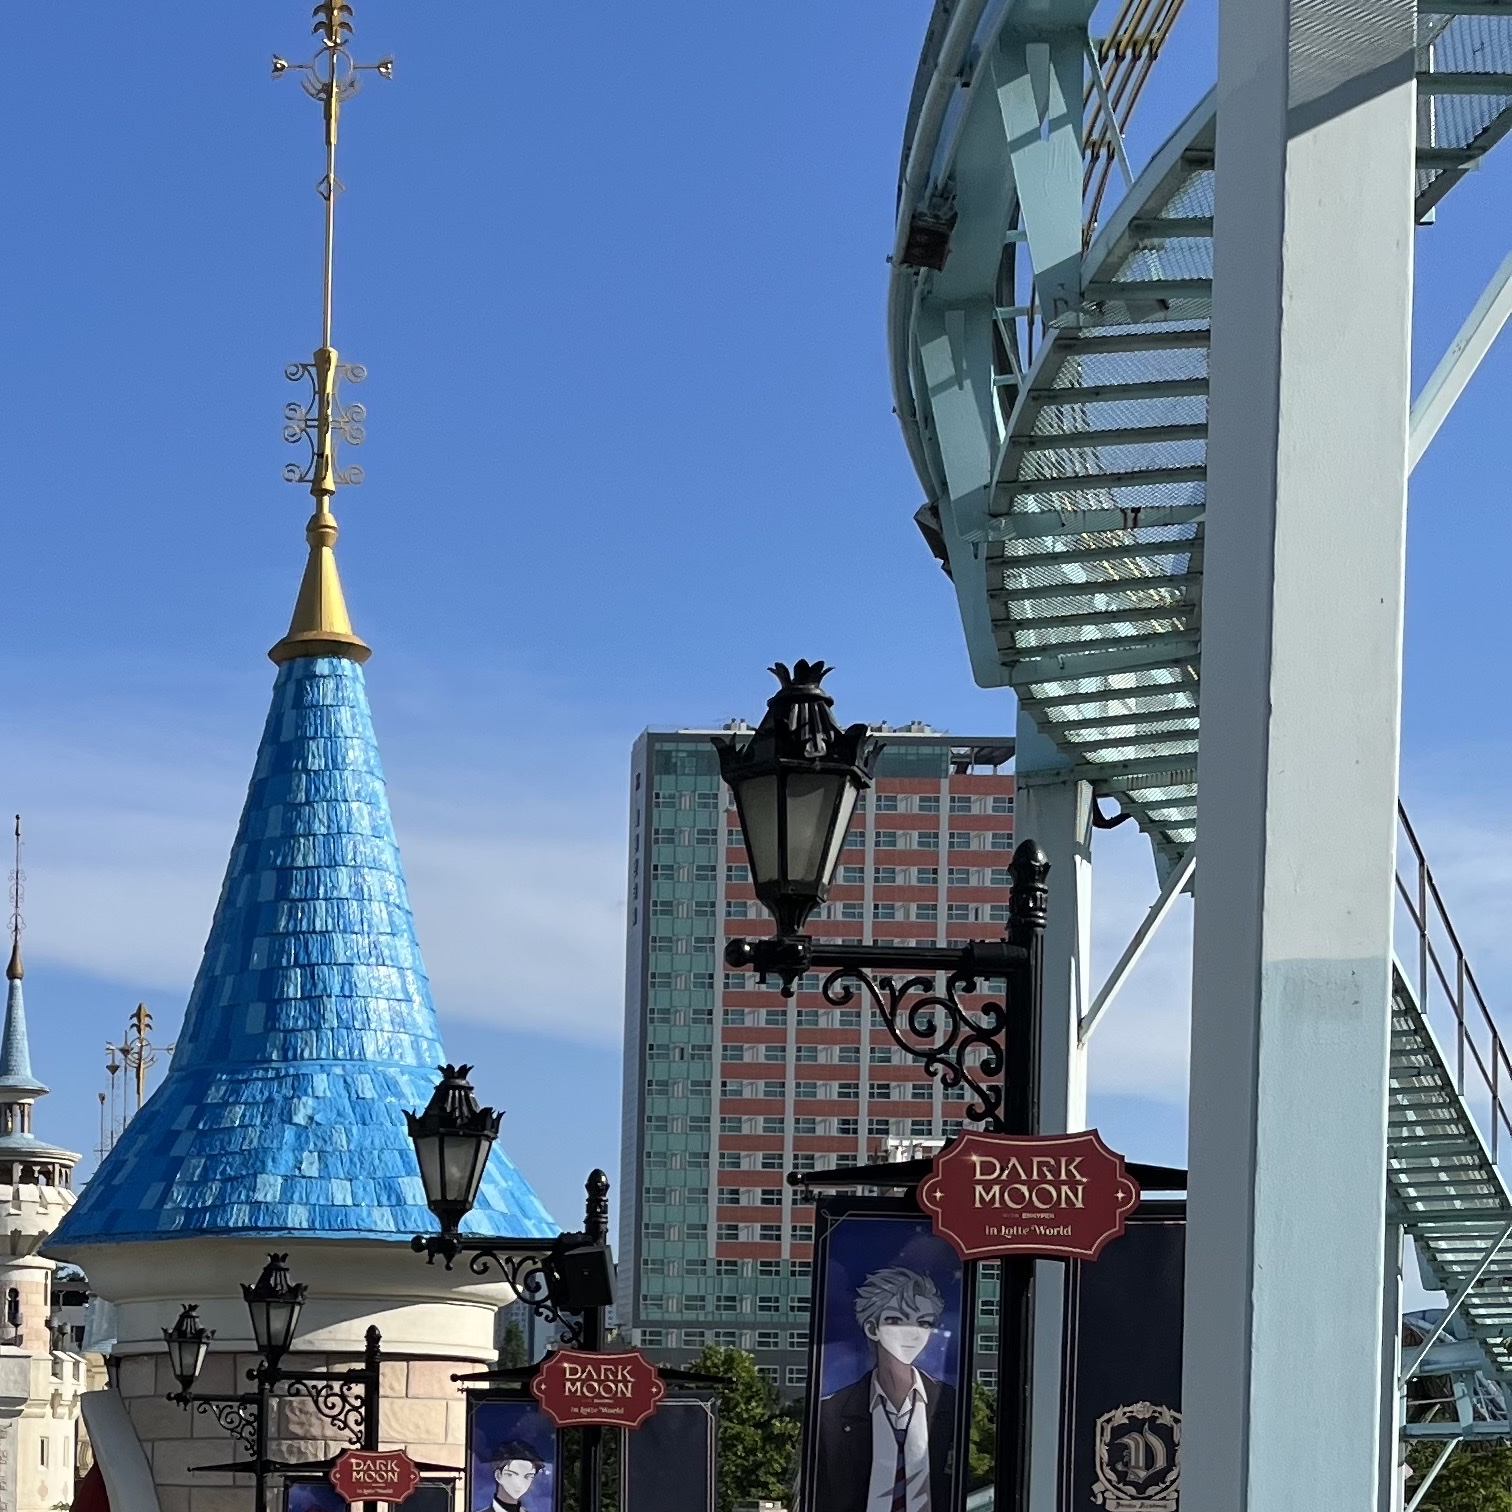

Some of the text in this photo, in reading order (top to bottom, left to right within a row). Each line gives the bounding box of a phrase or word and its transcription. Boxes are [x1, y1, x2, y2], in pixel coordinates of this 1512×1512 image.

[973, 1155, 1088, 1183] DARK
[973, 1183, 1085, 1209] MOON
[1031, 1225, 1072, 1236] World
[563, 1363, 634, 1382] DARK
[564, 1380, 632, 1398] MOON
[350, 1458, 400, 1472] DARK
[351, 1471, 398, 1483] MOON
